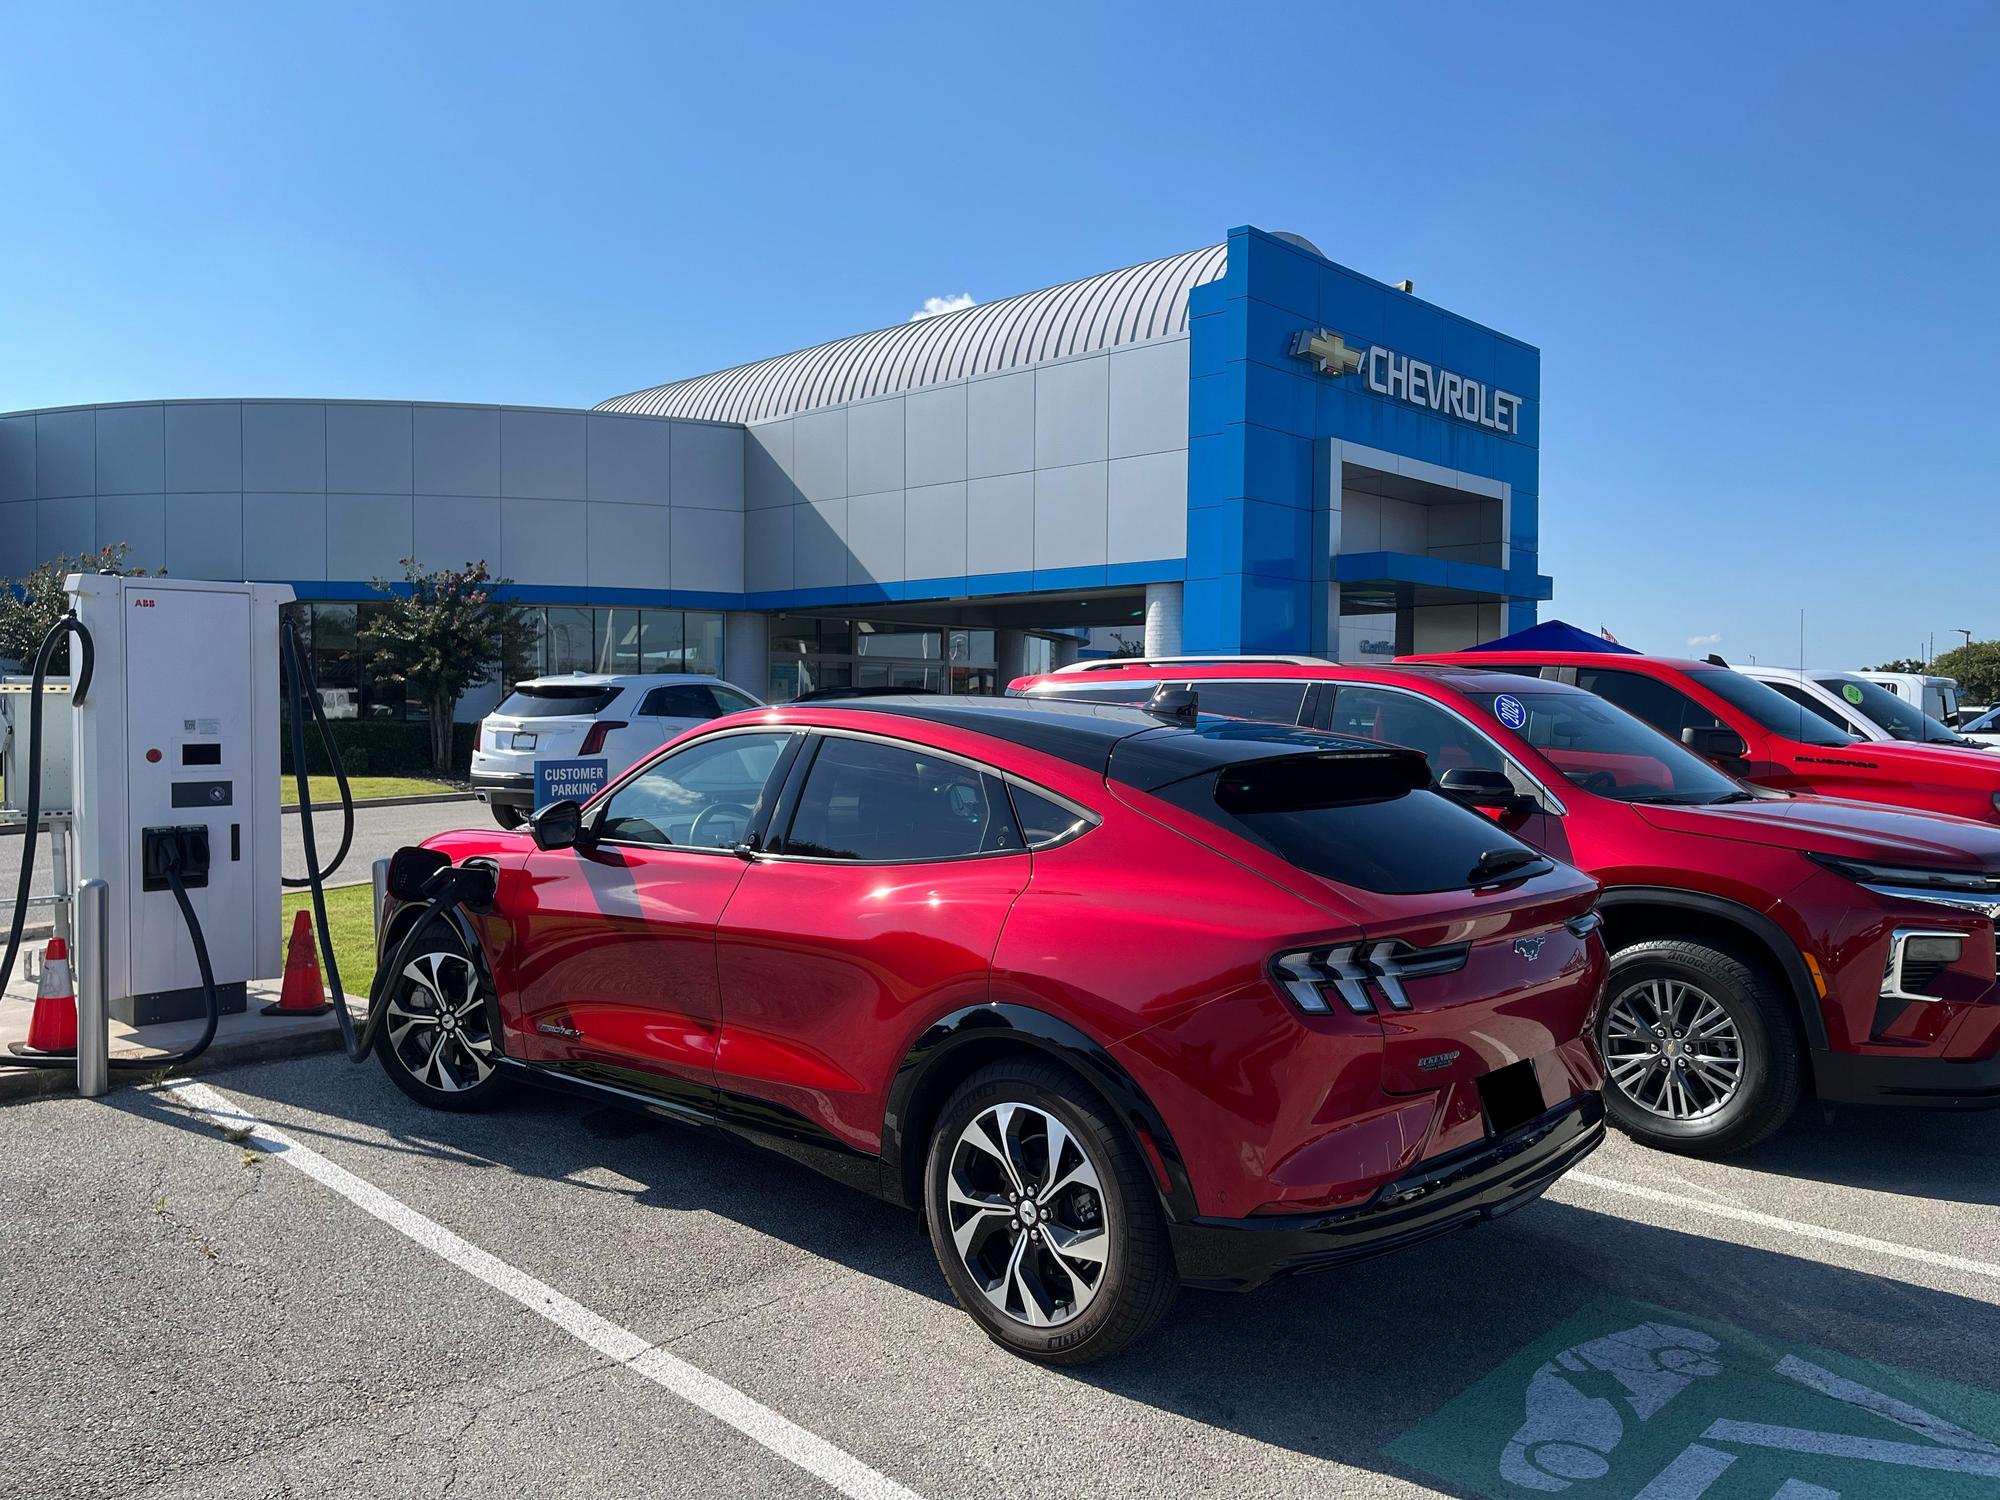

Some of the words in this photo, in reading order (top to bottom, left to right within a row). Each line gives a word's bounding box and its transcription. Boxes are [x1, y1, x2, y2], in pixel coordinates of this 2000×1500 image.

[1368, 345, 1522, 434] CHEVROLET
[135, 599, 155, 608] ABB
[1500, 697, 1519, 725] 2024
[544, 767, 604, 781] CUSTOMER
[551, 782, 598, 796] PARKING
